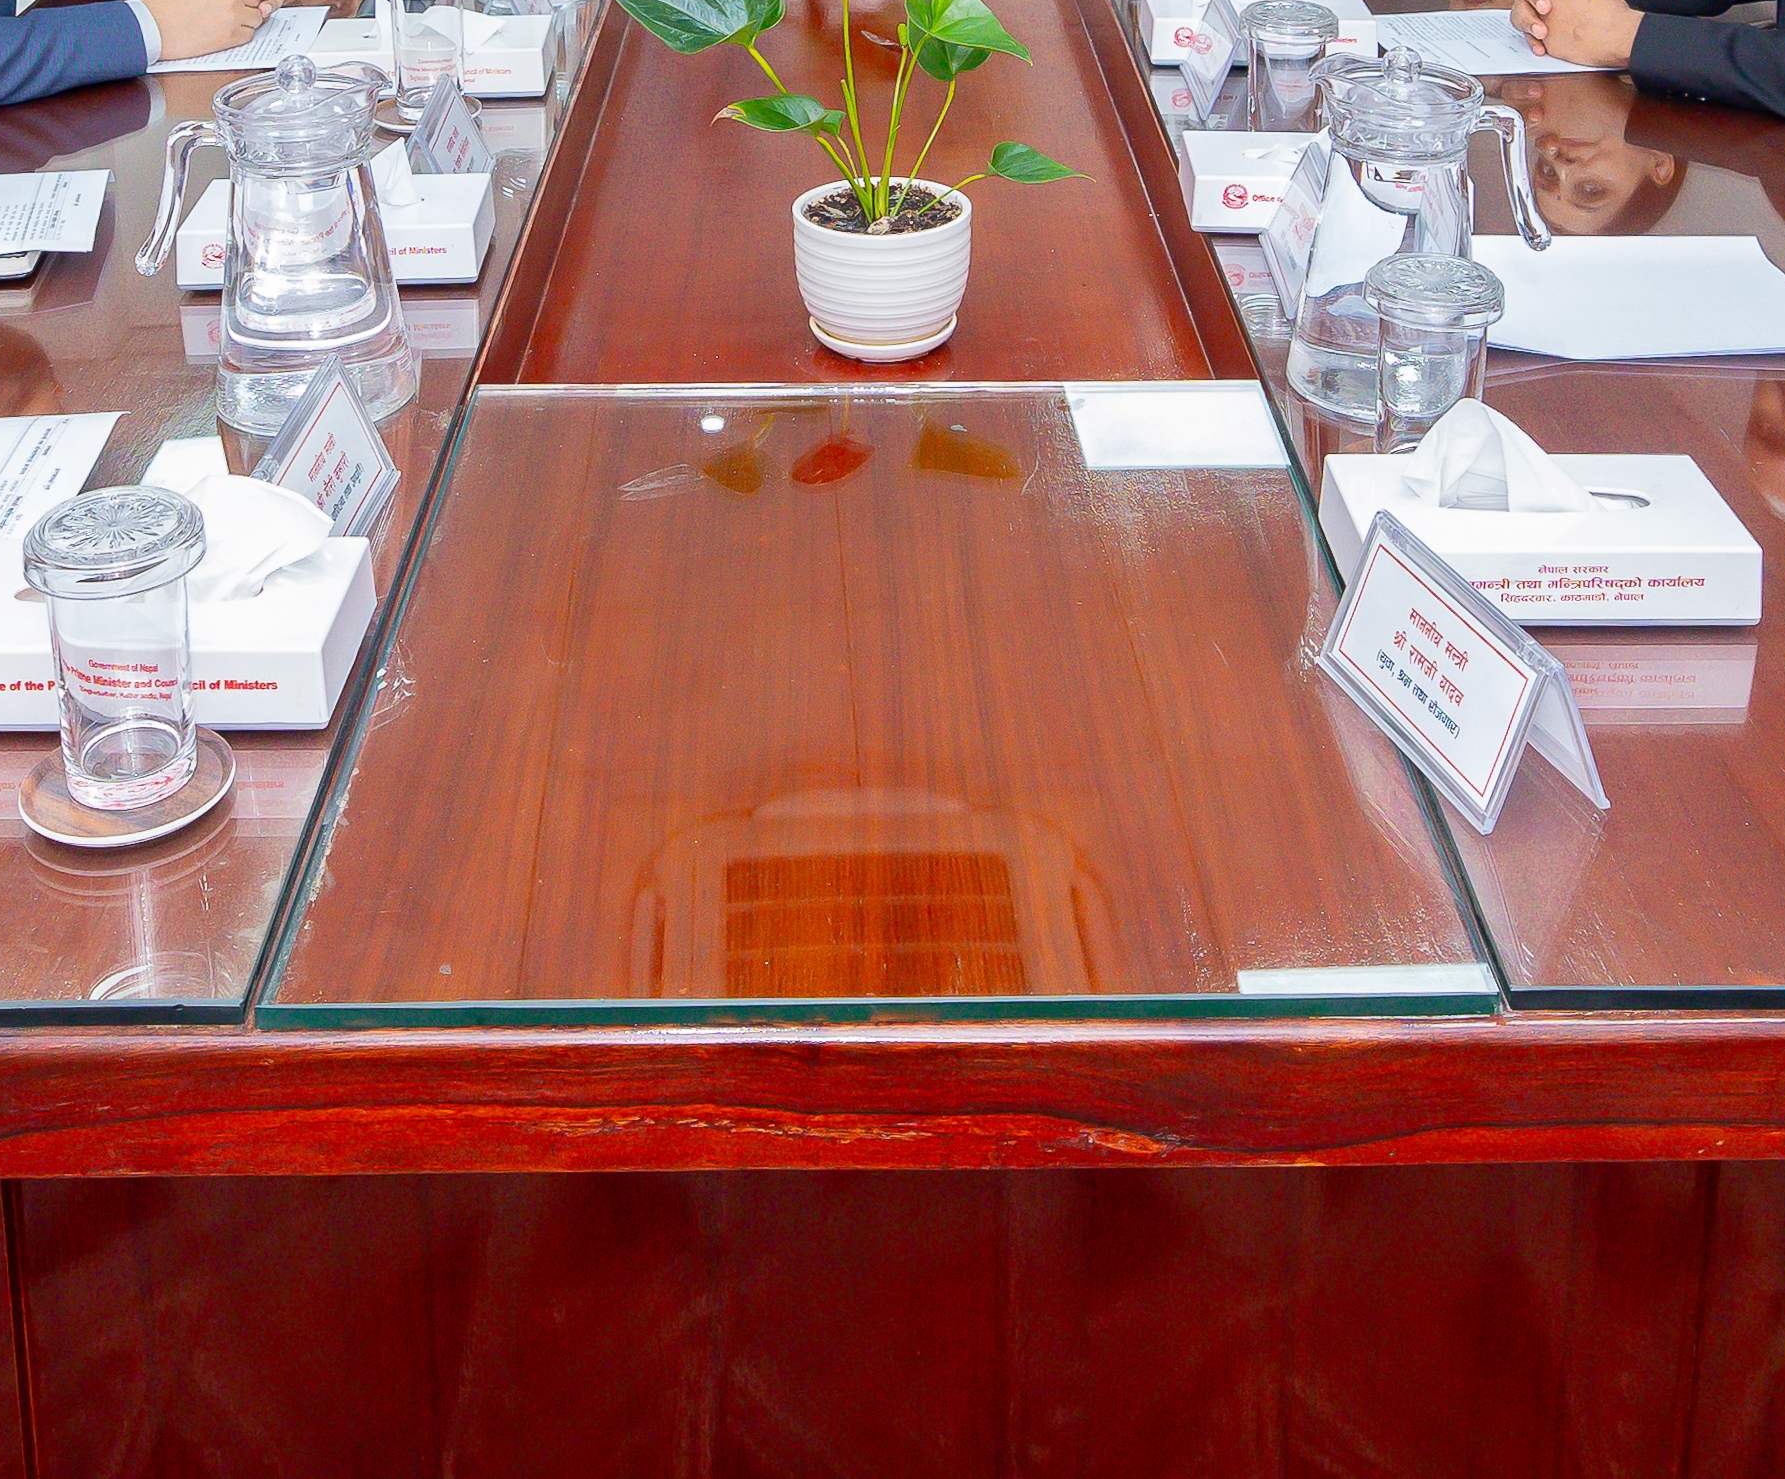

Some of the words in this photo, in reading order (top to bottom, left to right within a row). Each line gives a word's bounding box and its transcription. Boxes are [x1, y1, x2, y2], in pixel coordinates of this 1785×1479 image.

[409, 247, 447, 255] Ministers
[1538, 565, 1568, 574] नेपाल
[1573, 565, 1609, 574] सरकार
[1647, 575, 1705, 588] कार्यालय
[1409, 608, 1444, 648] माननीय
[1445, 640, 1469, 672] मन्त्री
[1393, 630, 1407, 651] श्री
[1409, 644, 1438, 680] रामजी
[1439, 674, 1464, 708] यादव
[9, 680, 21, 692] of
[24, 680, 44, 691] the
[93, 675, 131, 688] Minister
[134, 679, 152, 688] and
[209, 679, 221, 691] of
[223, 679, 278, 691] Ministers
